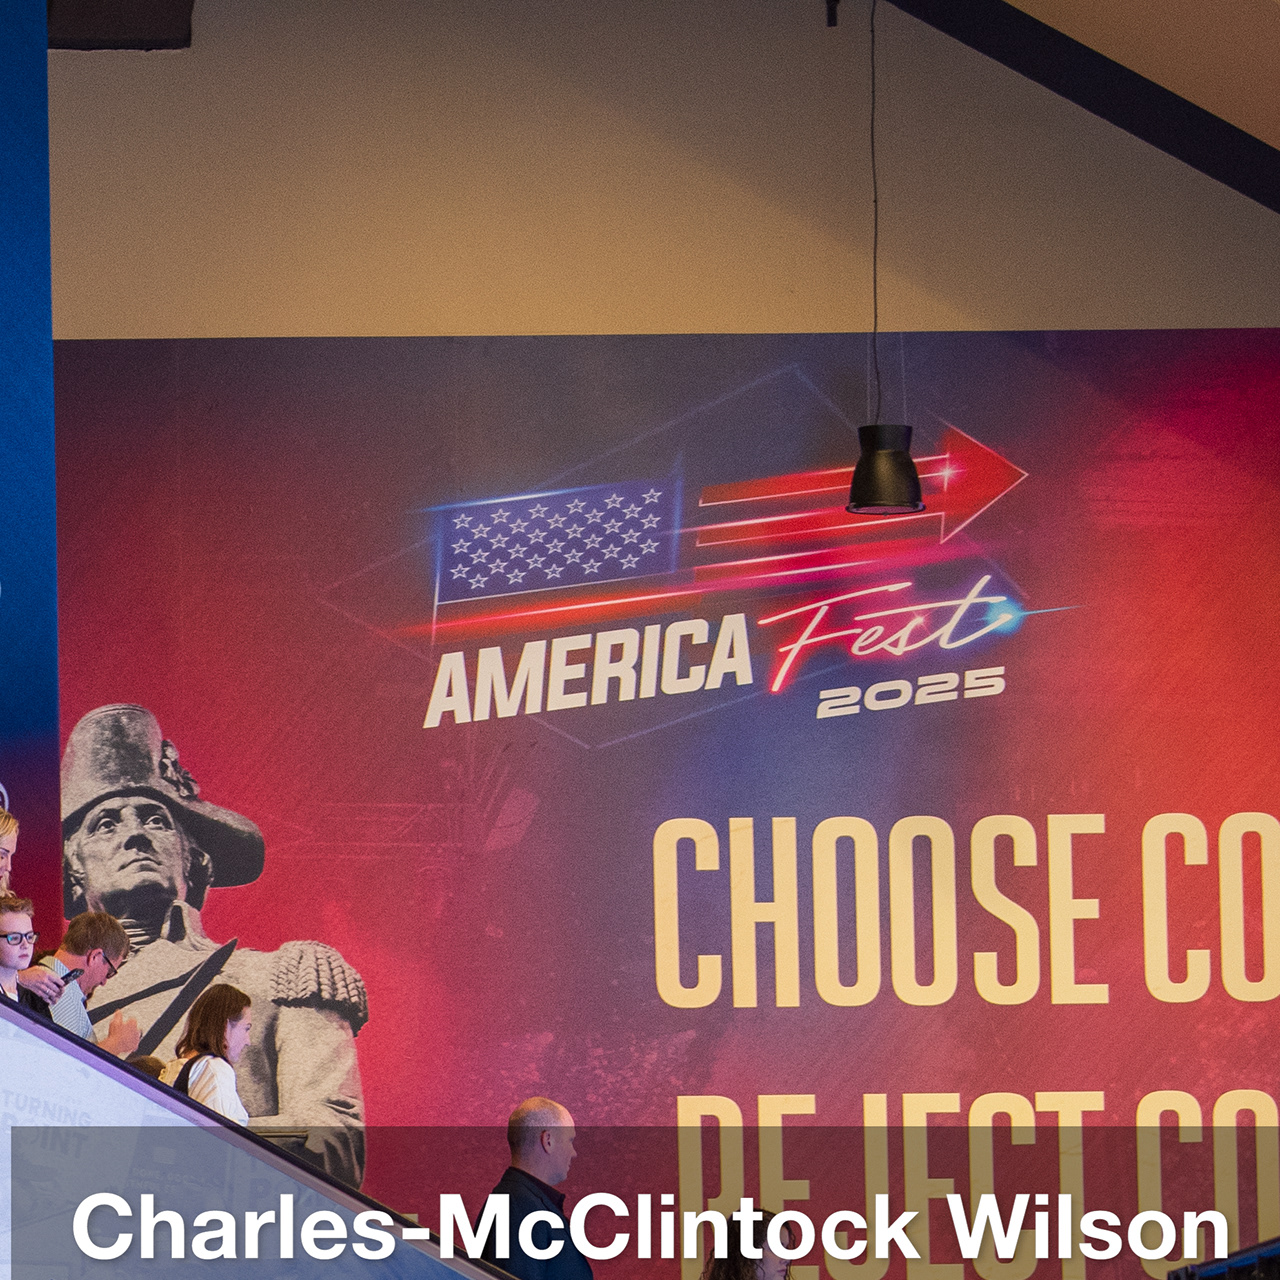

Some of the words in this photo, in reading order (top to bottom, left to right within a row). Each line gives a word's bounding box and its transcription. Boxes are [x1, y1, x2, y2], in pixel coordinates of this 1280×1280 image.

[423, 613, 754, 729] AMERICA
[758, 575, 1013, 692] Fest
[816, 666, 1007, 719] 2025
[653, 813, 1109, 1009] CHOOSE
